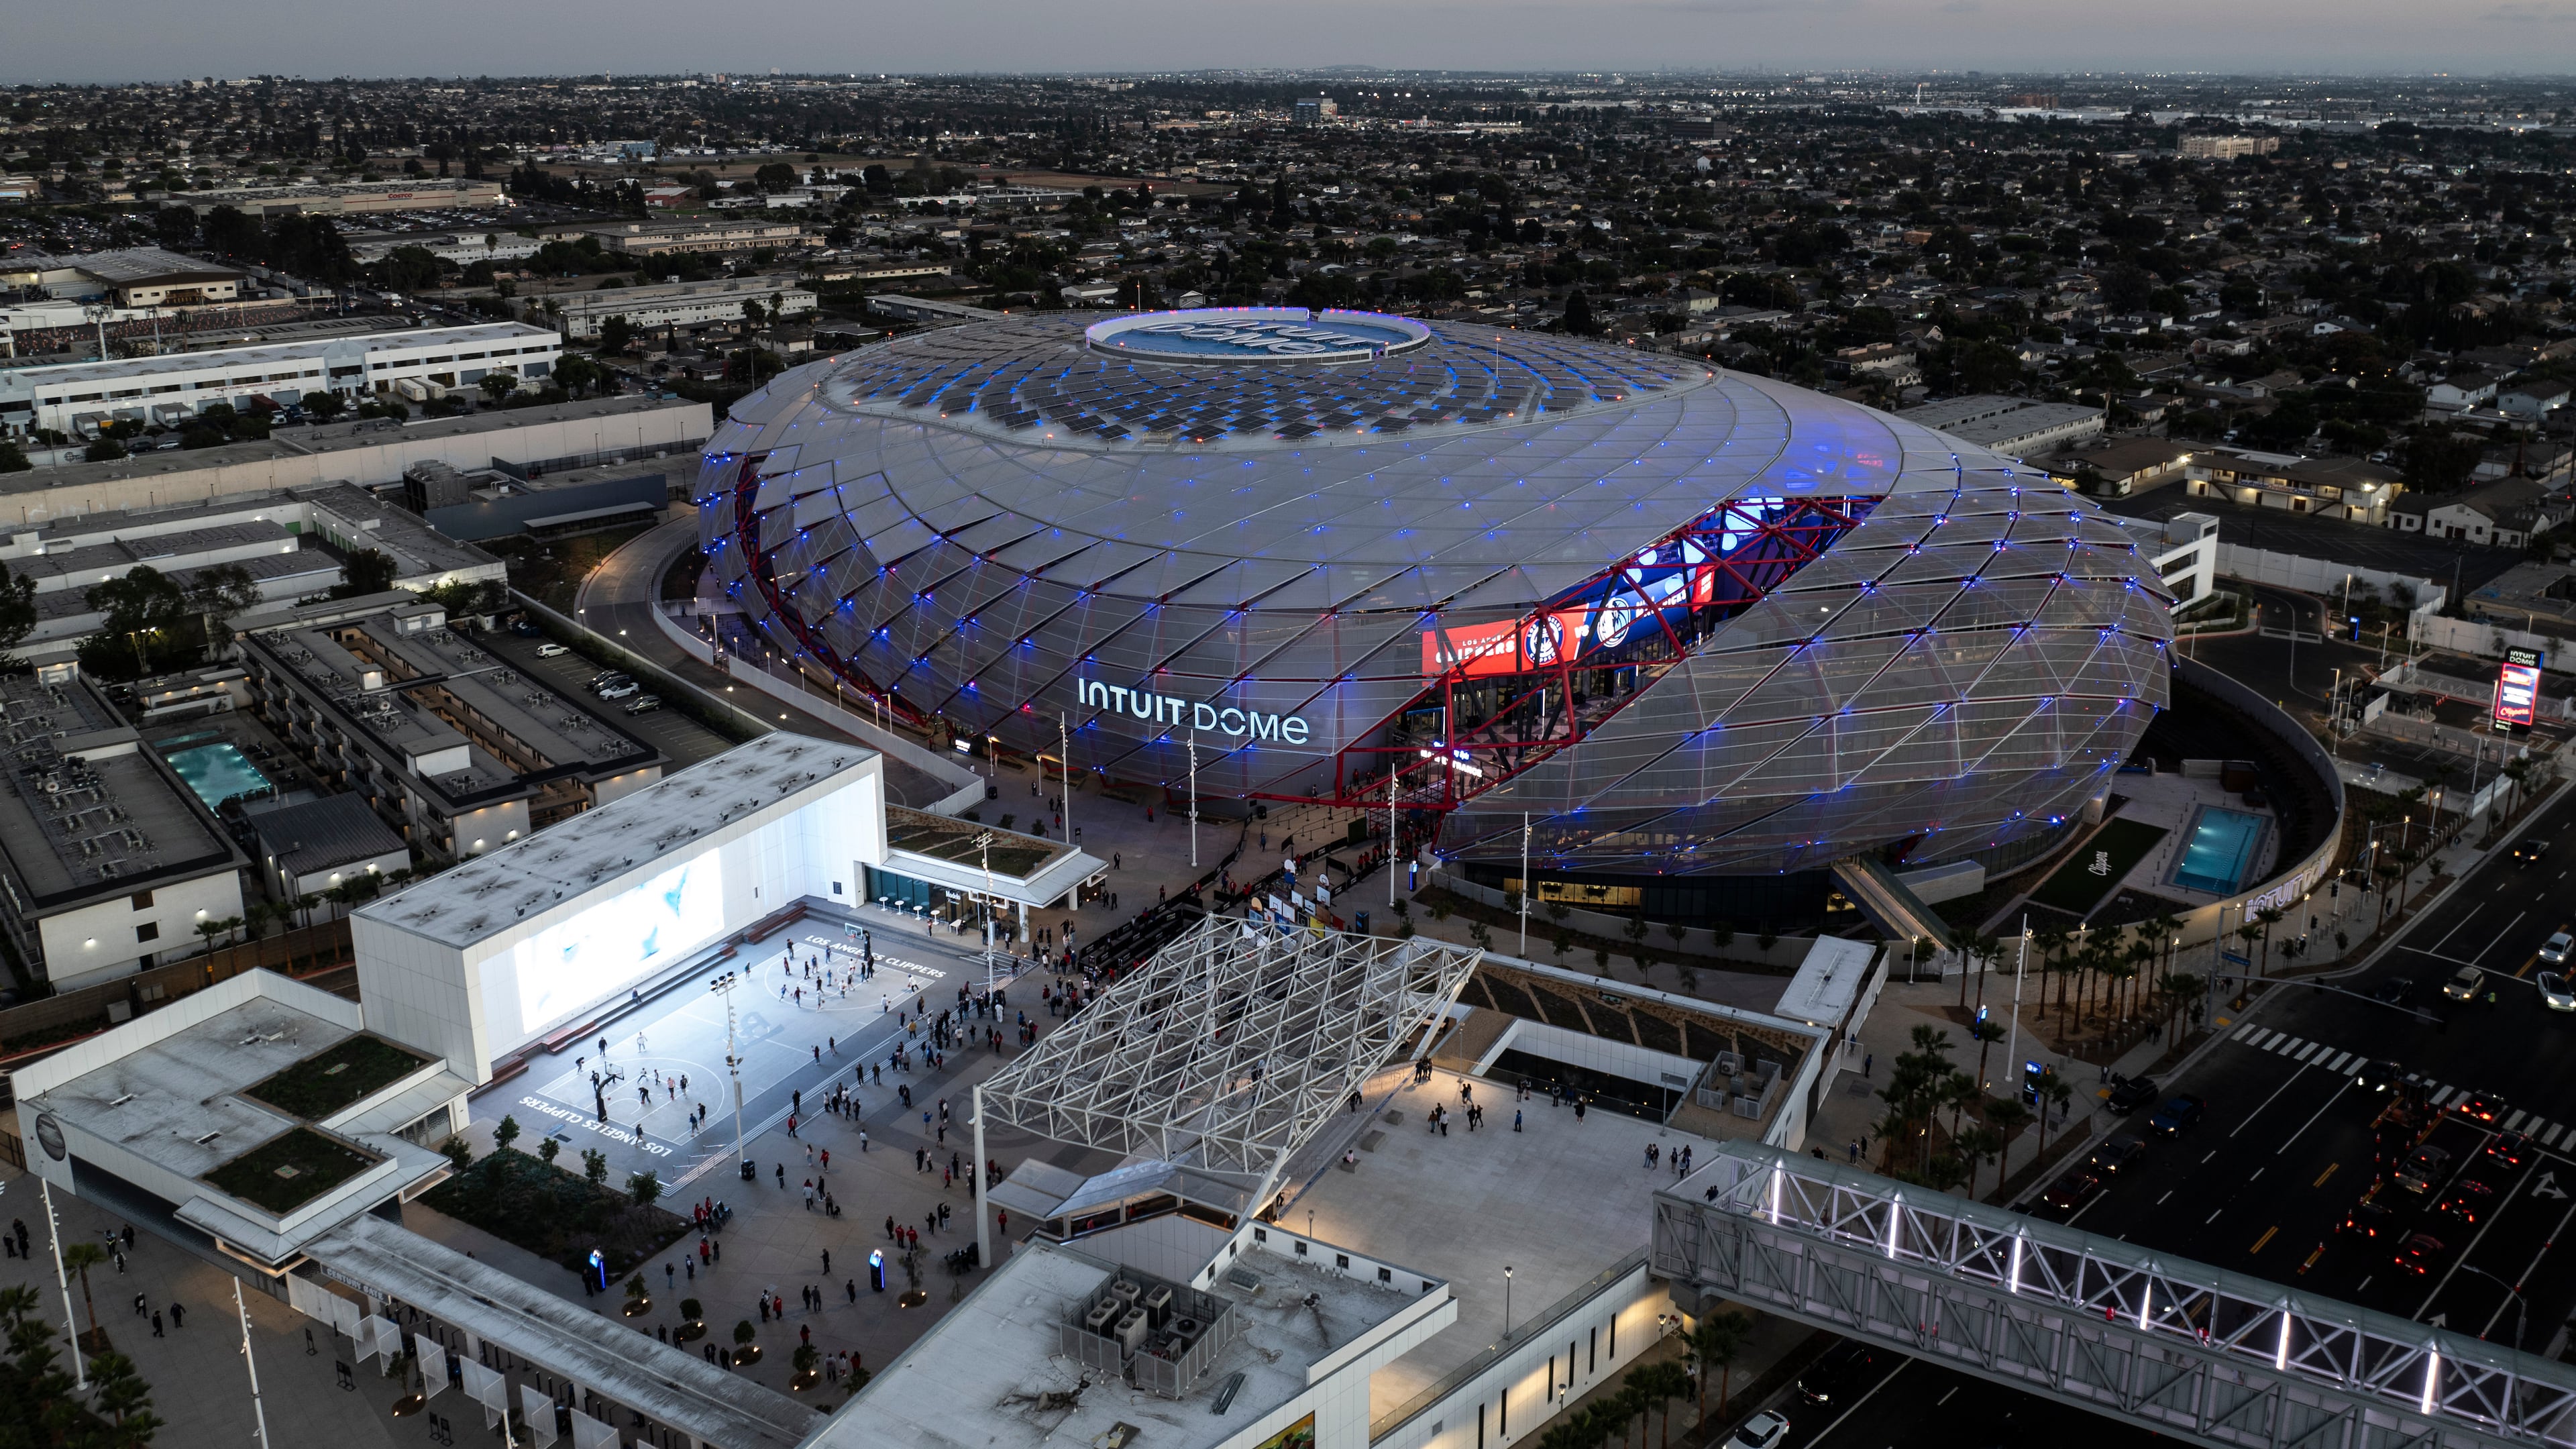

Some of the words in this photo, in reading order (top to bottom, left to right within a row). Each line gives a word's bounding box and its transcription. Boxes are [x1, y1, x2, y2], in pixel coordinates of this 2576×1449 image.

[804, 934, 832, 946] LOS
[829, 943, 885, 961] ANGEES
[885, 957, 947, 978] CLIPPERS
[519, 1095, 584, 1124] CLIPPERS
[581, 1118, 643, 1147] ANGELES
[641, 1142, 674, 1158] LOS
[327, 1267, 362, 1290] CENTURY
